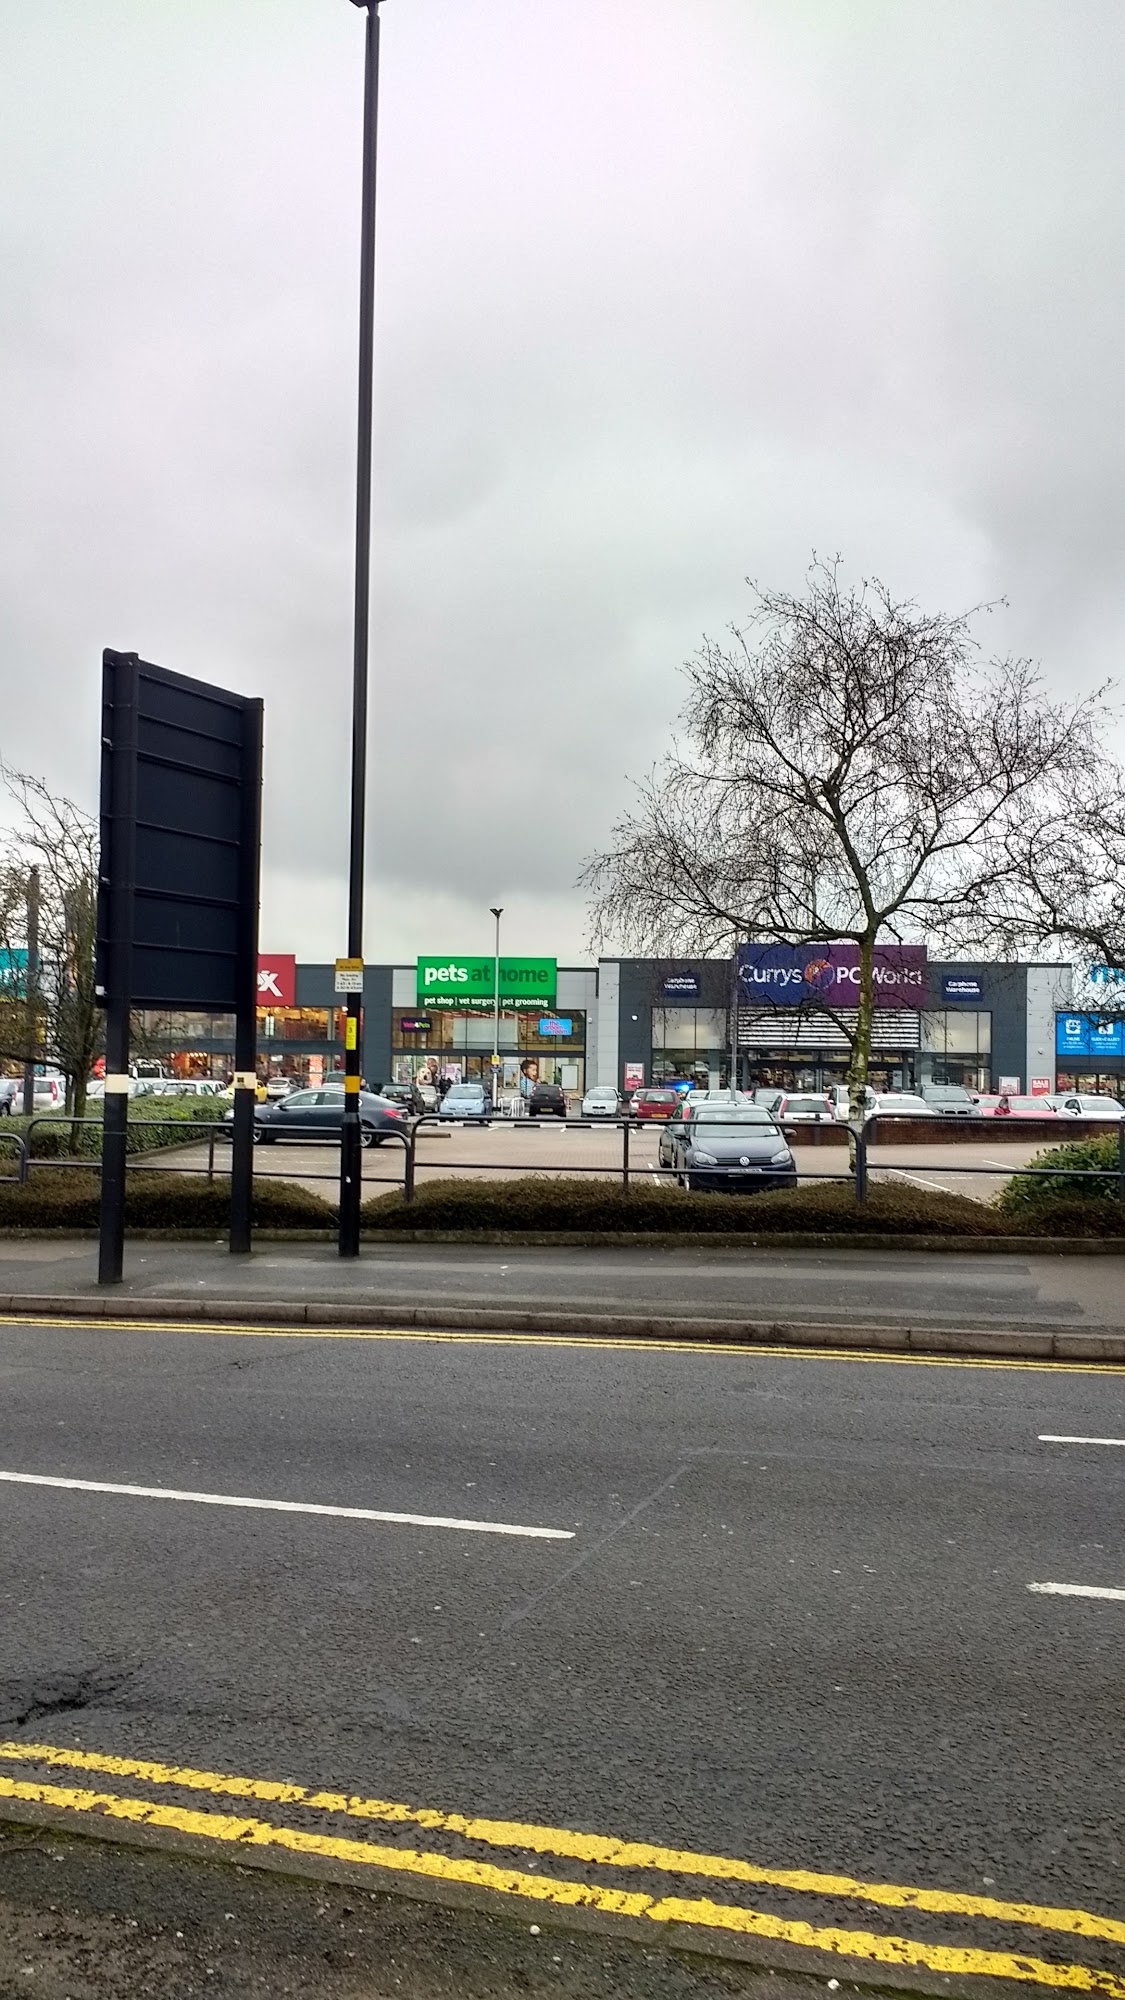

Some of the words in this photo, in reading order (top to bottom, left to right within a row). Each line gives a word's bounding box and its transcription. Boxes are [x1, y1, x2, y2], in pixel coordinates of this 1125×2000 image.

[424, 964, 468, 986] pets
[471, 965, 491, 982] at
[738, 964, 802, 987] Currys
[836, 966, 861, 984] PC
[424, 997, 437, 1006] pet
[437, 996, 454, 1006] shop
[502, 998, 514, 1007] pet
[515, 998, 549, 1008] grooming
